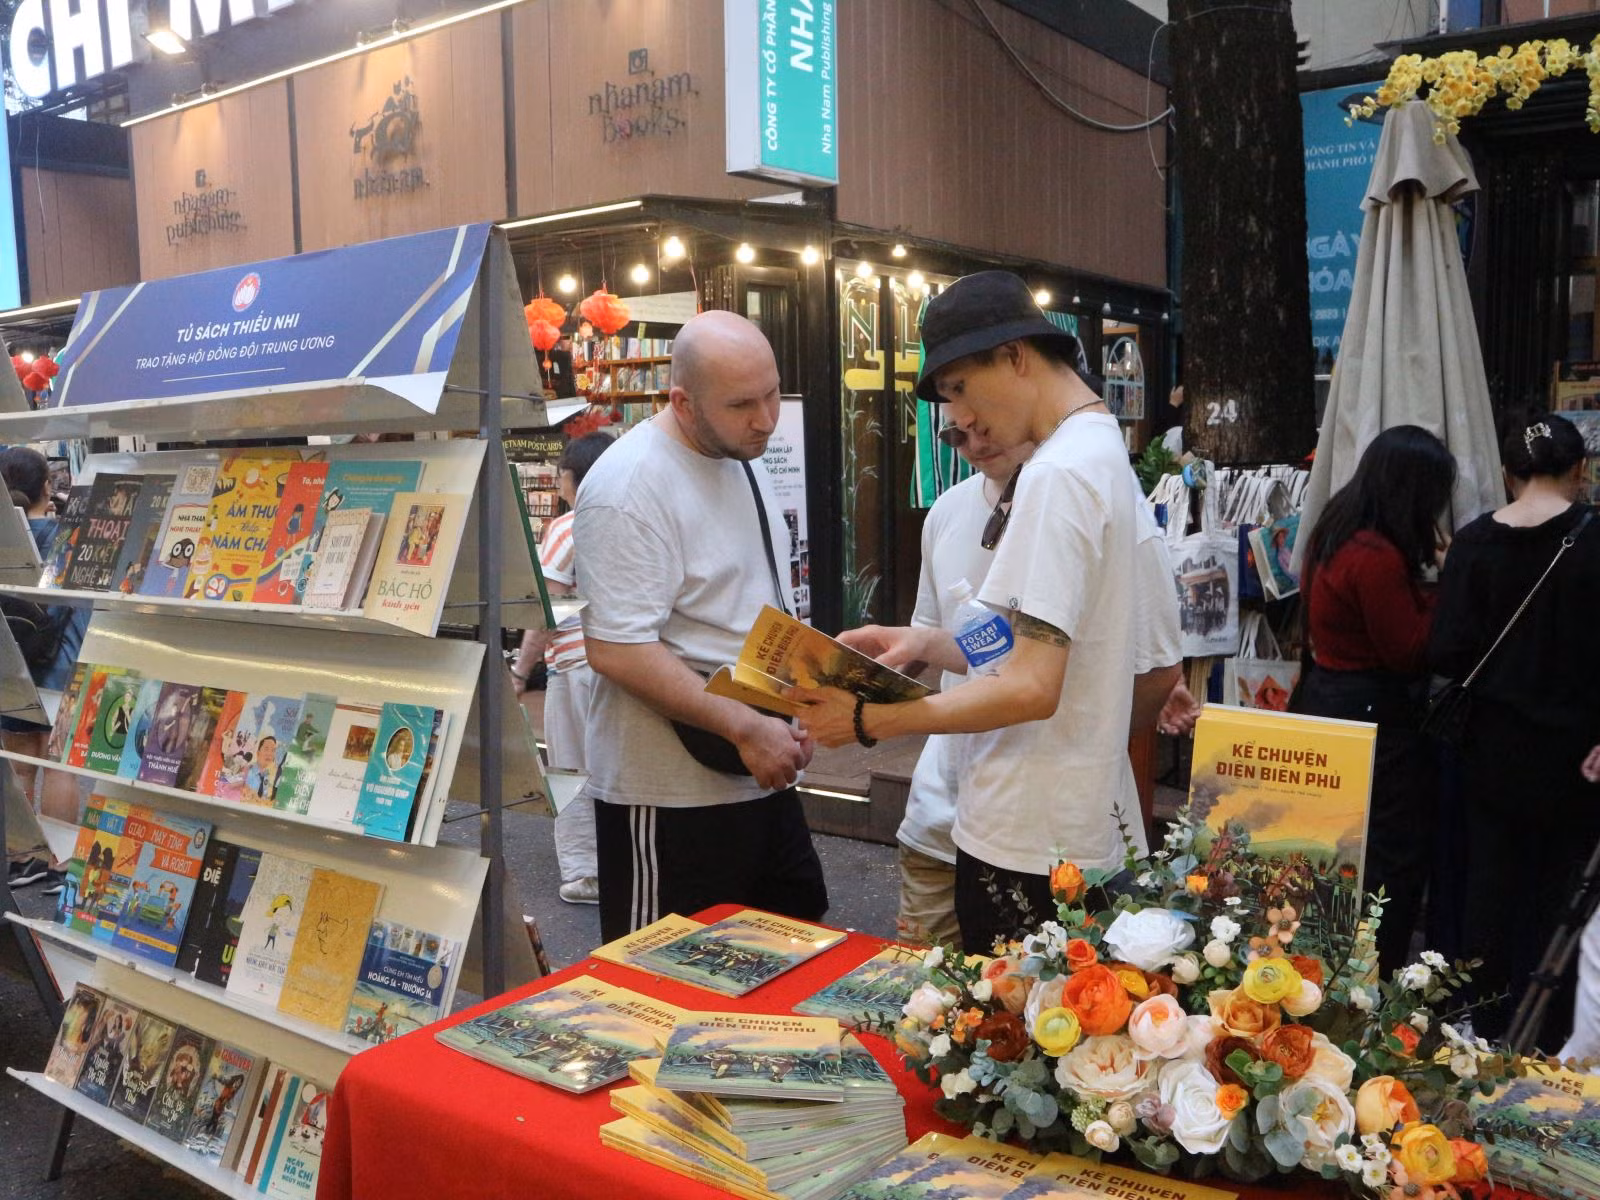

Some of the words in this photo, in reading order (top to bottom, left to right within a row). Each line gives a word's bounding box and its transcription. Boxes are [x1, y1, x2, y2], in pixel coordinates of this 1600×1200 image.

[820, 2, 832, 80] Publishing
[762, 50, 776, 74] CỔ
[767, 77, 777, 97] TY
[821, 84, 831, 120] Nam
[765, 102, 778, 150] CÔNG
[821, 124, 832, 154] Nha
[1306, 145, 1334, 157] ÔNG
[1337, 142, 1356, 153] TIN
[1306, 158, 1339, 171] HÀNH
[177, 323, 193, 343] TỦ
[195, 317, 230, 341] SÁCH
[233, 310, 272, 336] THIẾU
[273, 312, 300, 331] NHI
[136, 356, 160, 370] TRAO
[161, 354, 186, 369] TẶNG
[187, 350, 205, 364] HỘI
[206, 343, 237, 362] ĐỒNG
[239, 343, 260, 359] ĐỘI
[261, 339, 298, 356] TRUNG
[300, 335, 335, 351] ƯƠNG
[1206, 399, 1238, 426] 24
[502, 439, 527, 449] IETNAM
[527, 441, 563, 451] POSTCARDS
[251, 505, 279, 519] THỰ
[77, 544, 91, 562] 20
[377, 578, 409, 598] BÁC
[410, 578, 433, 600] HỒ
[962, 624, 998, 647] POCARI
[966, 632, 998, 653] SWEAT
[1232, 740, 1256, 759] KỂ
[1257, 746, 1328, 769] CHUYỆN
[1216, 760, 1256, 780] ĐIỆN
[1260, 765, 1300, 785] BIÊN
[1305, 770, 1341, 789] PHỦ
